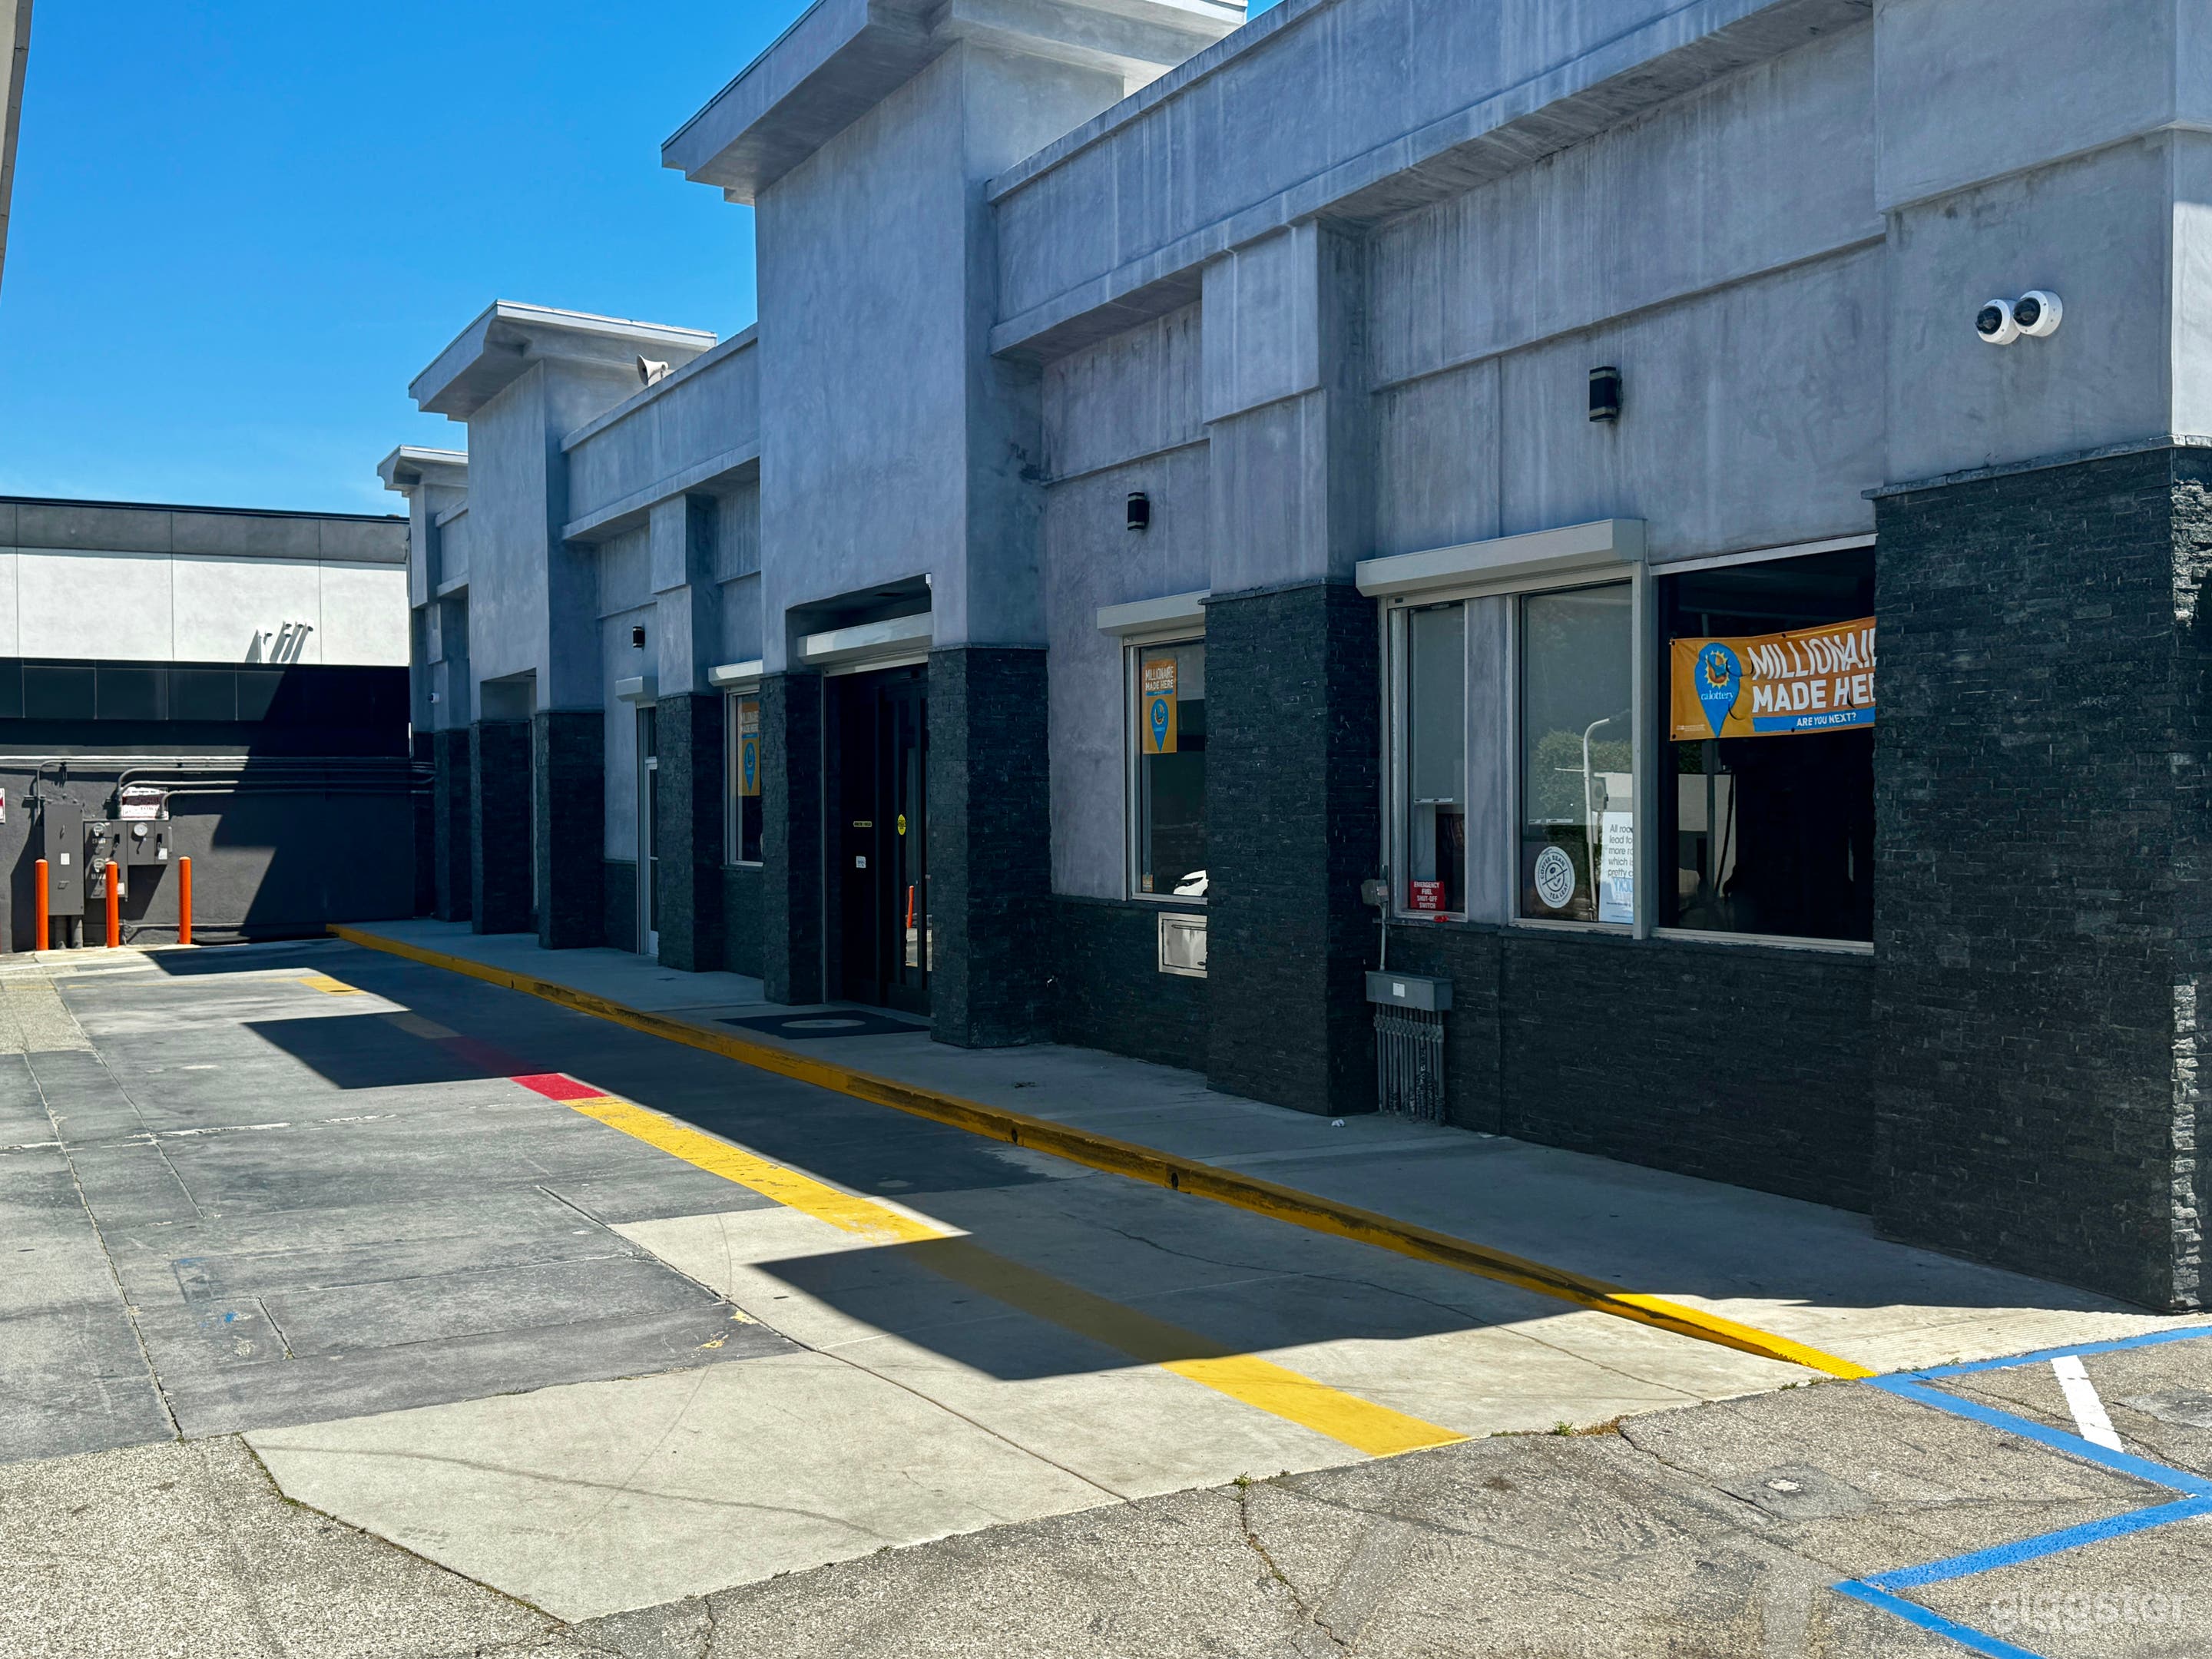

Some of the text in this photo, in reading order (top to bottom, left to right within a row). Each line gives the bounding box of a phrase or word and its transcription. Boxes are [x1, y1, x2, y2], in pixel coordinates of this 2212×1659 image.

[1145, 666, 1174, 681] MILLIONAIRE
[1145, 679, 1174, 691] MADE HERE
[1752, 680, 1826, 713] MADE
[1796, 712, 1856, 727] ARE YOU NEXT?
[1609, 835, 1624, 843] lead
[1608, 857, 1628, 866] which
[1608, 869, 1627, 878] pretty
